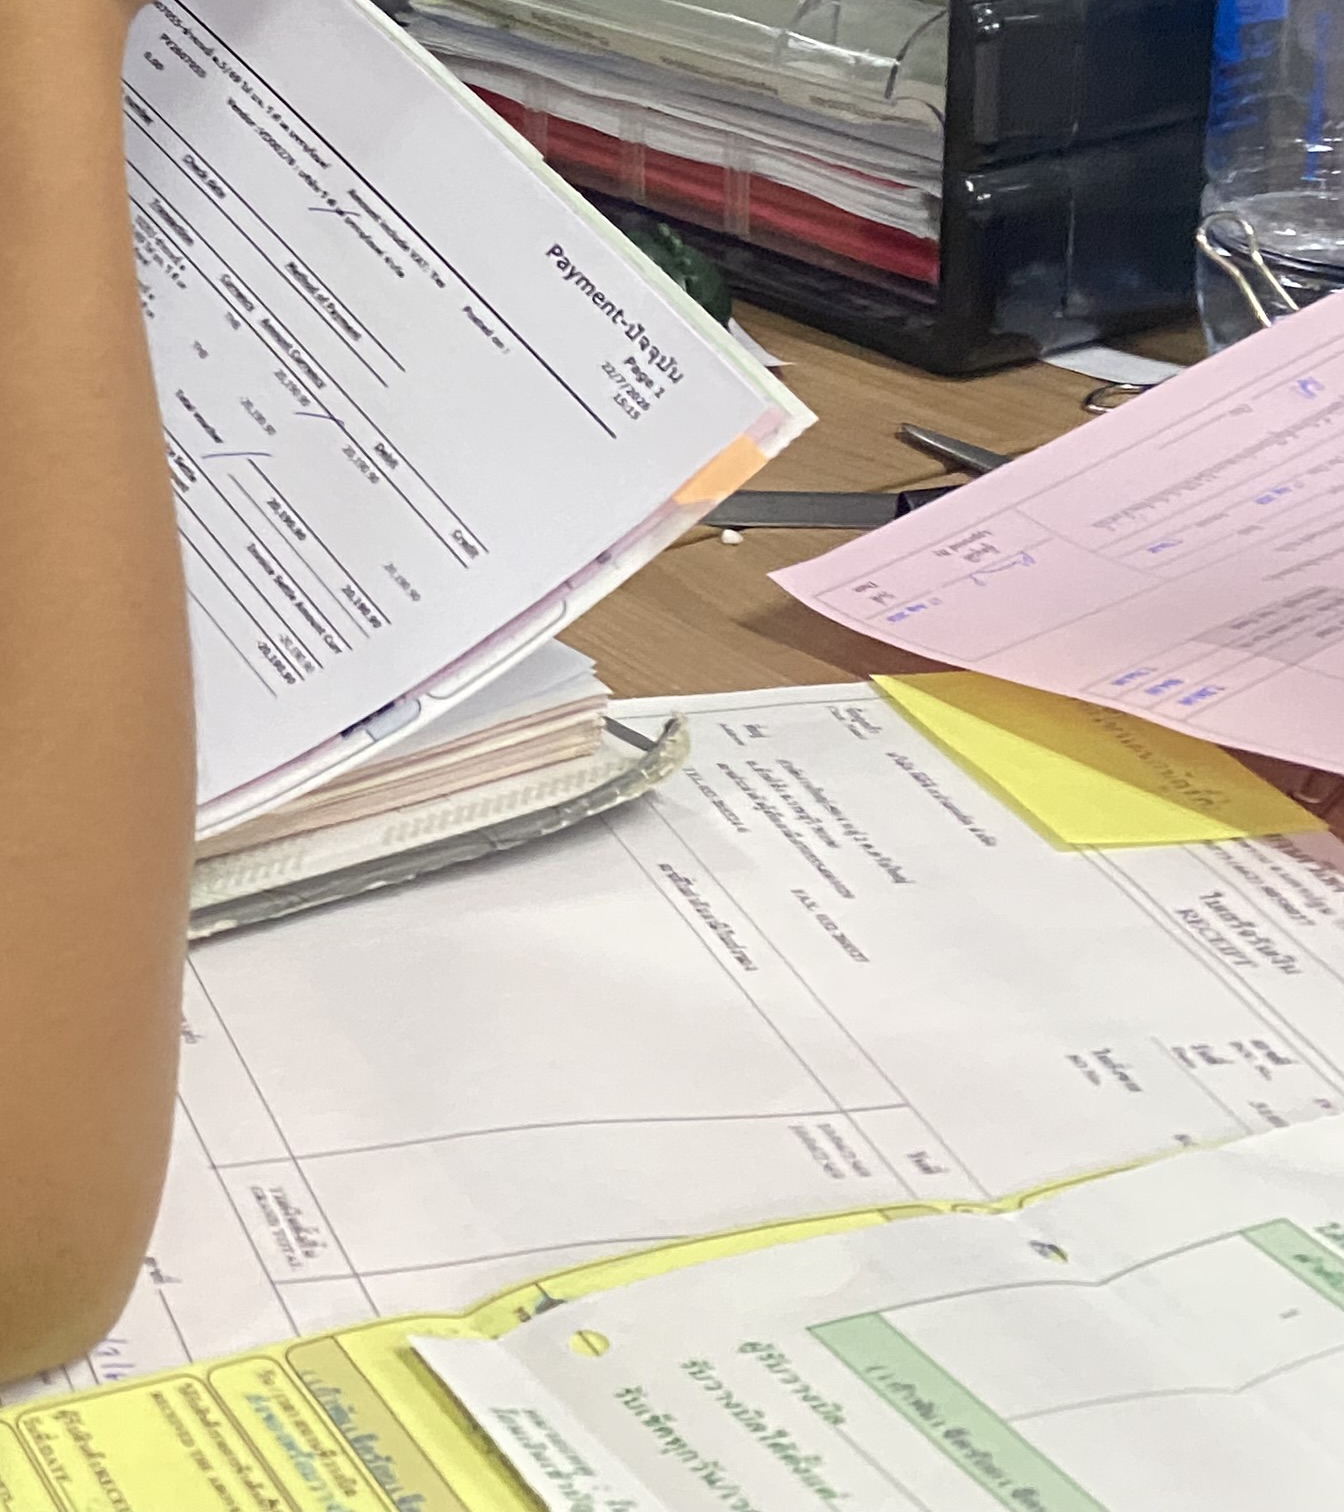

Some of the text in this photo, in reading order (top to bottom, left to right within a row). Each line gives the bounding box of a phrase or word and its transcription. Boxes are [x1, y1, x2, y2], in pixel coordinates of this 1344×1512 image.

[545, 243, 685, 385] Payment-ปัจจุบัน
[624, 356, 666, 399] Page 1
[1175, 909, 1258, 968] RECEIPT
